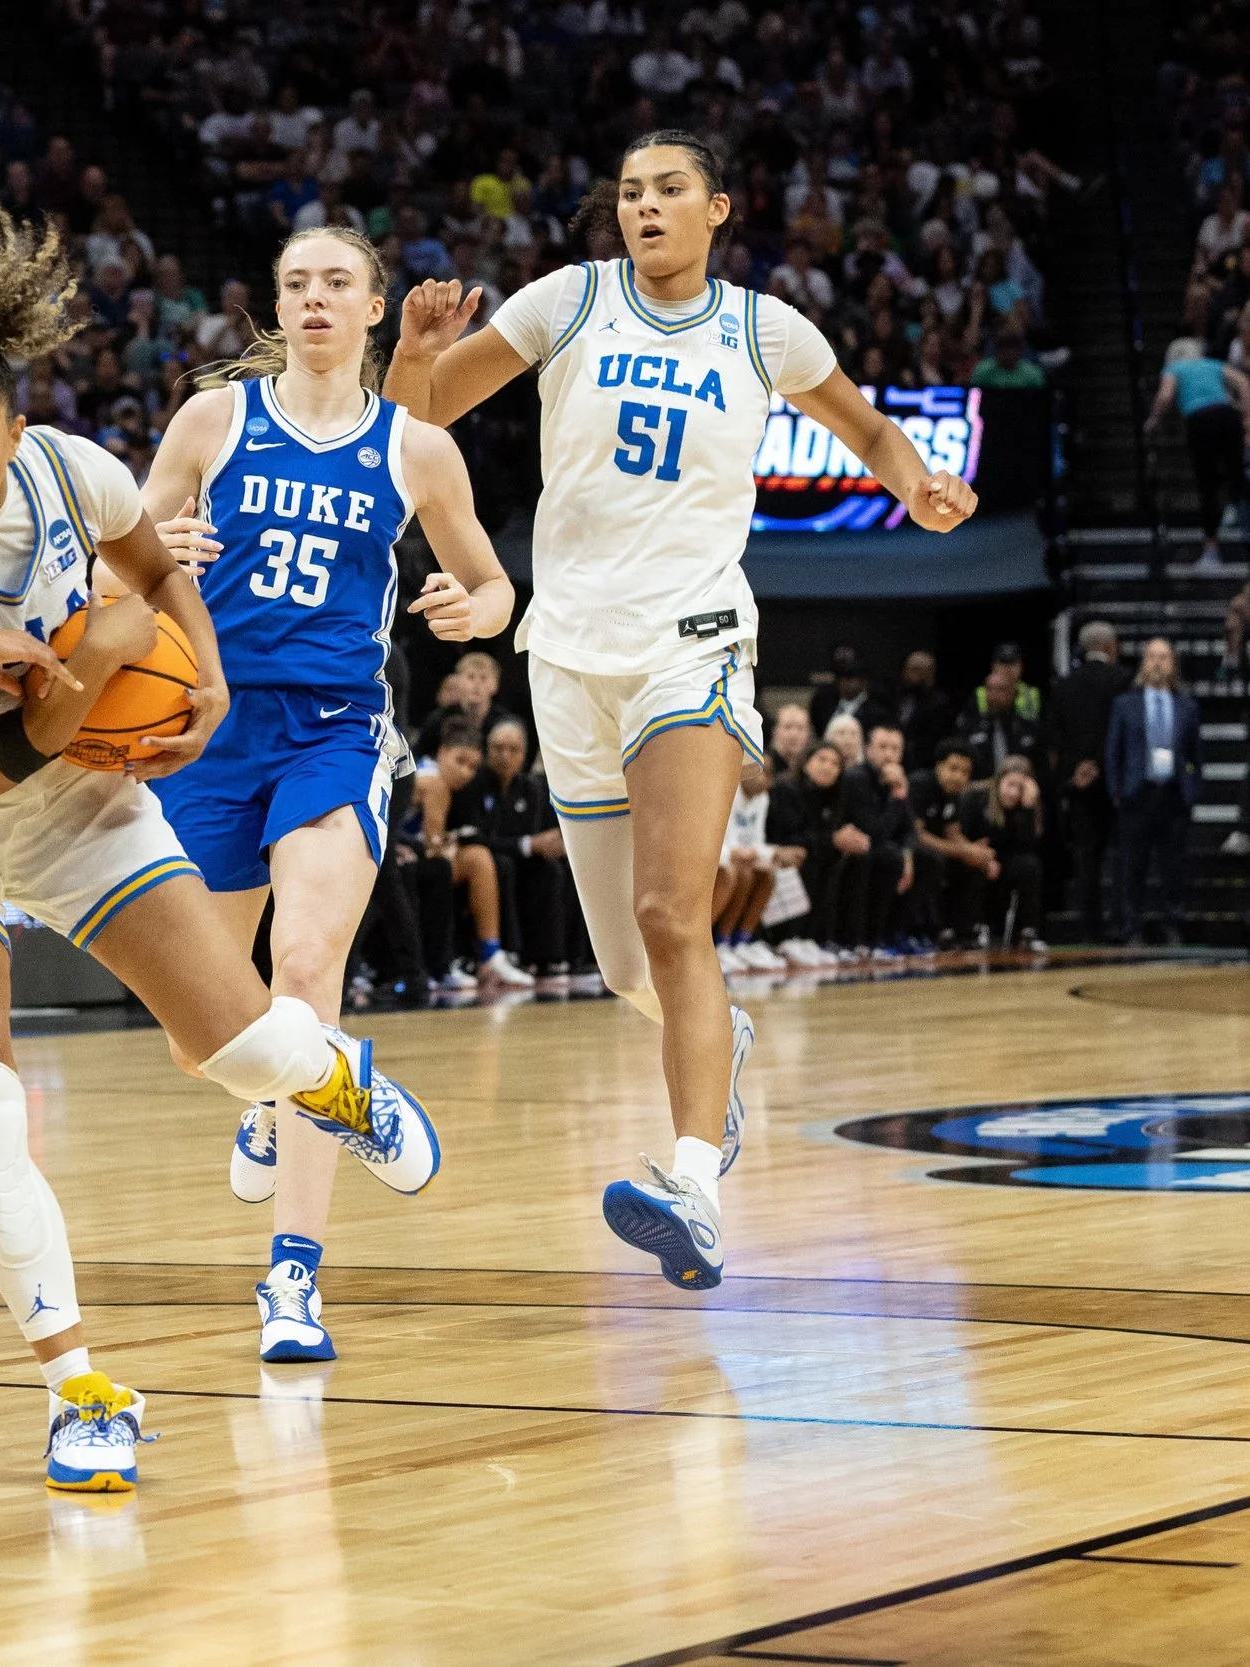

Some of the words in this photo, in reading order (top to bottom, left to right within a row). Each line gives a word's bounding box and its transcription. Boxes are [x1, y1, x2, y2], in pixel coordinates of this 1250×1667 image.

[597, 354, 726, 413] UCLA
[614, 400, 688, 482] 51
[240, 475, 375, 533] DUKE
[249, 528, 340, 608] 35
[719, 615, 729, 624] 50
